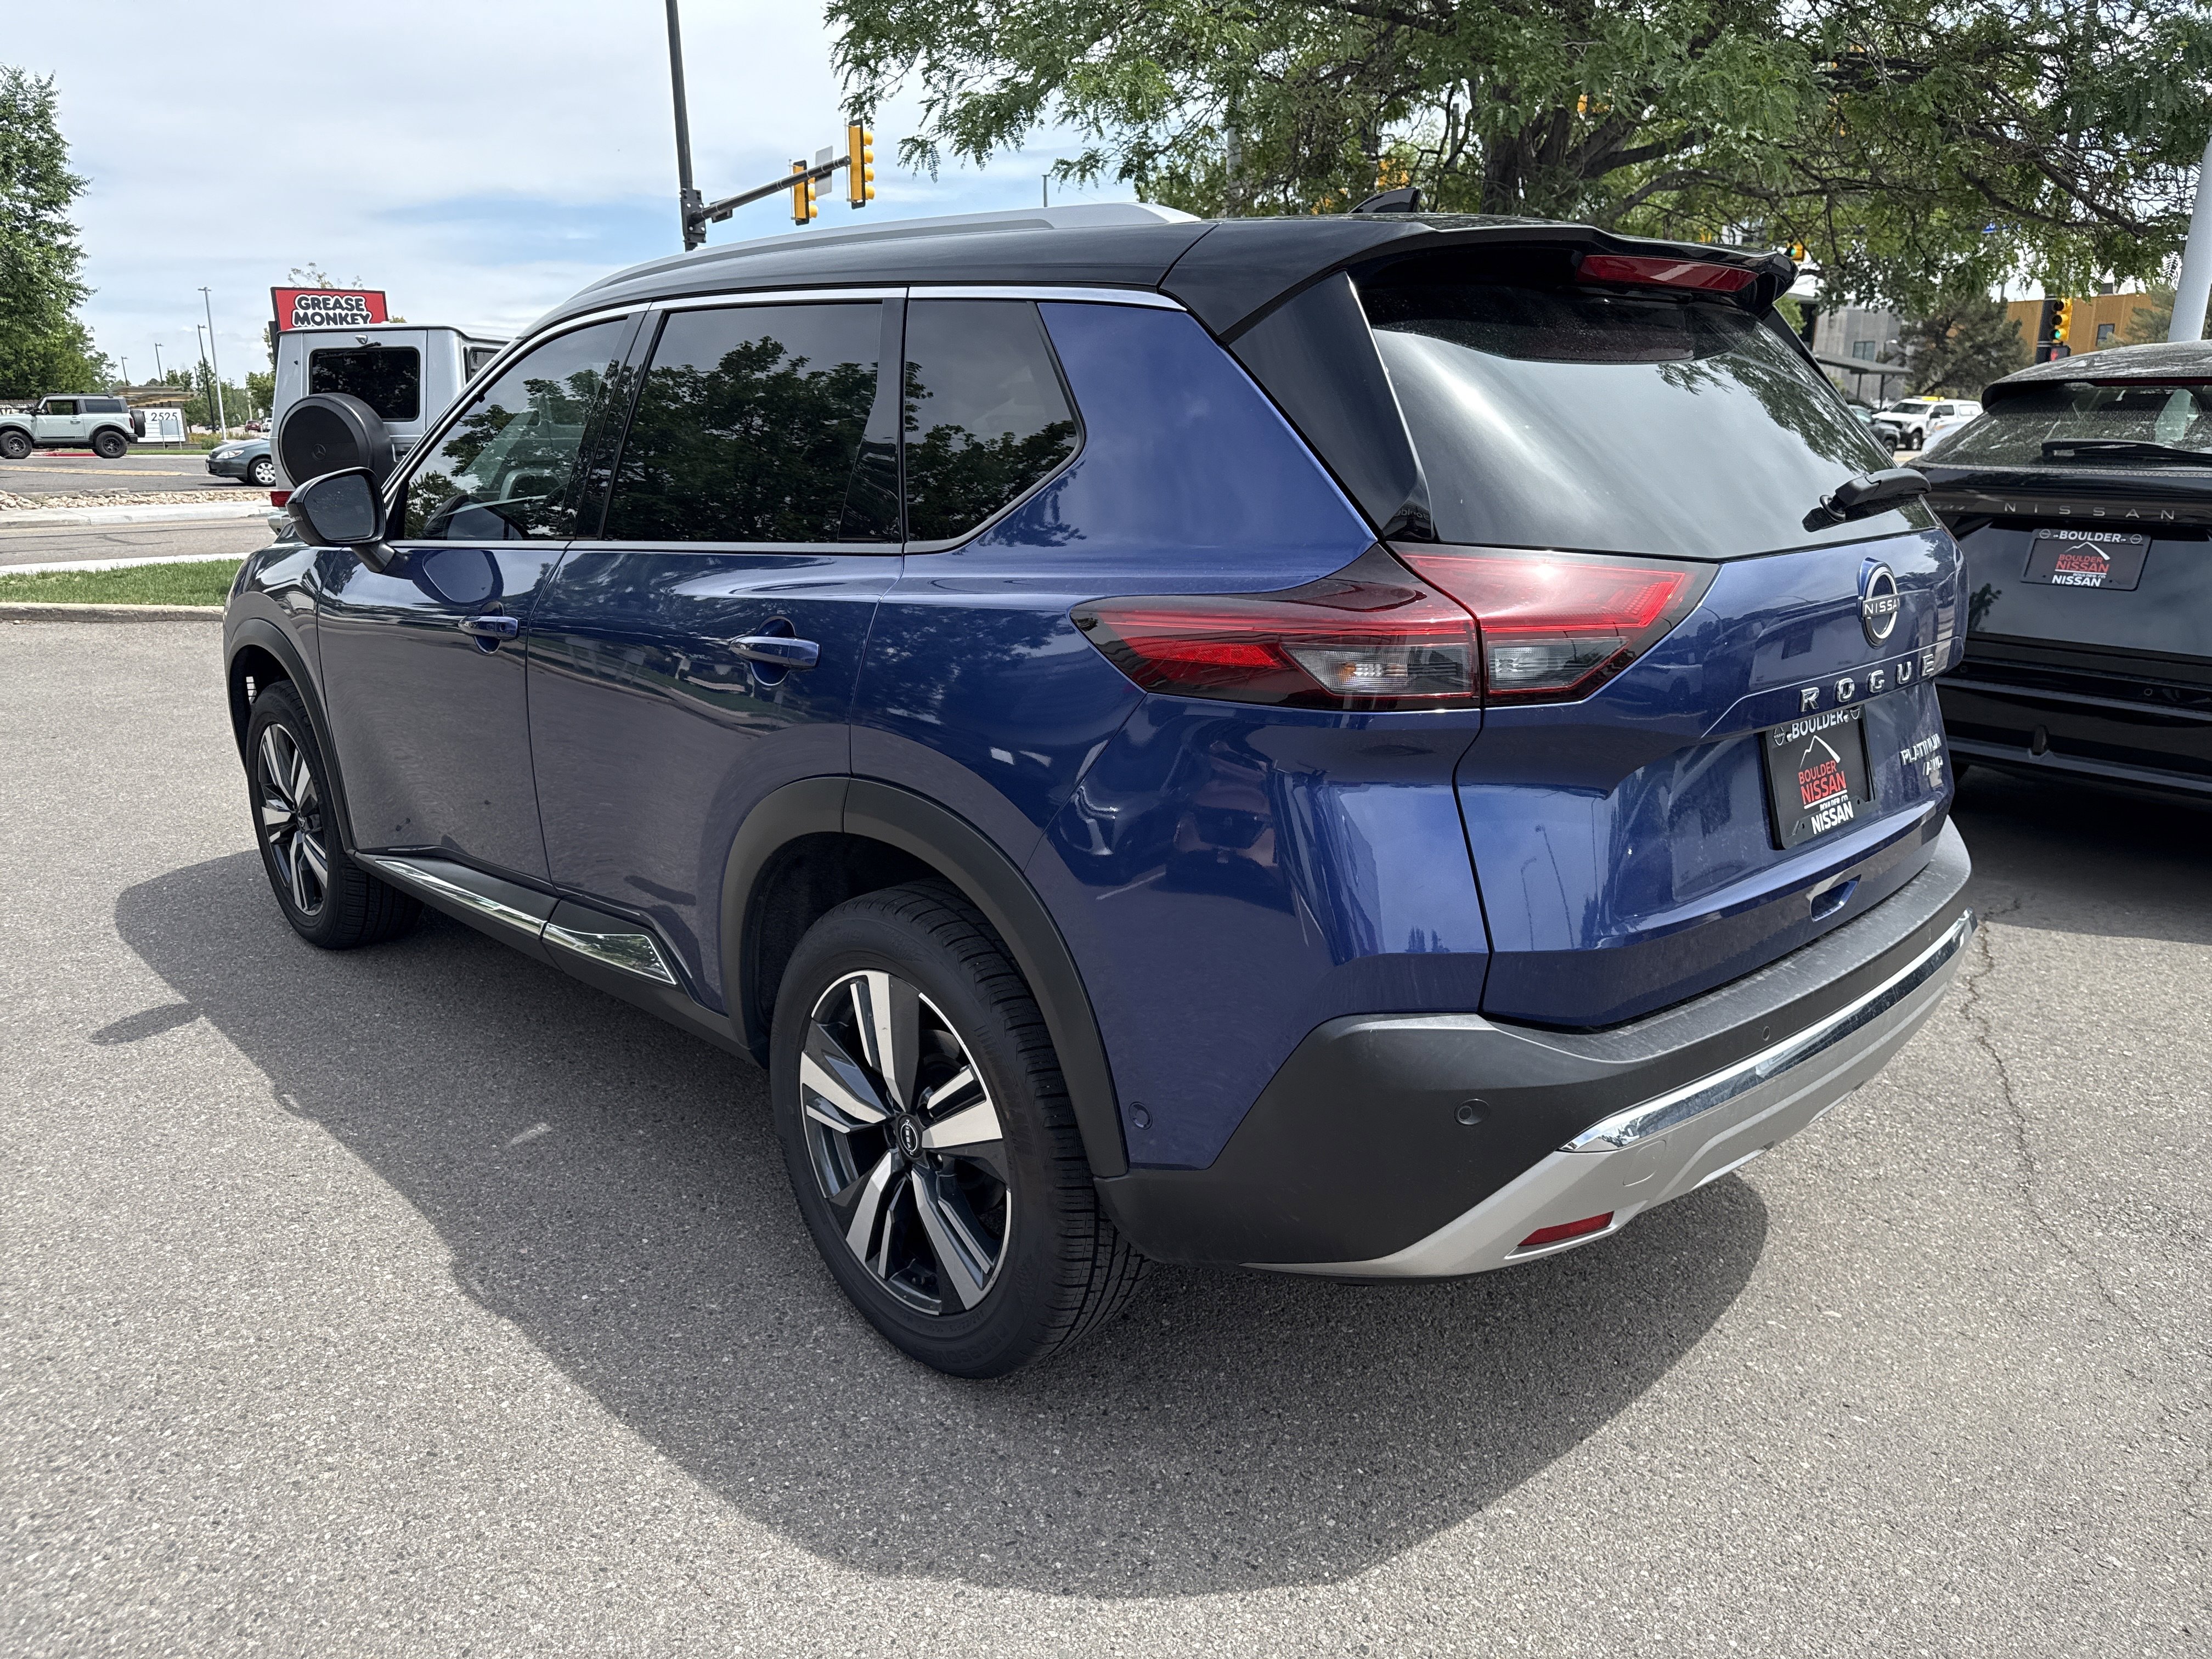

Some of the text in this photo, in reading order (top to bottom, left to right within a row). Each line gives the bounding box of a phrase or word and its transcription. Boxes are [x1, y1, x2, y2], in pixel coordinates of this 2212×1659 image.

[296, 296, 365, 312] GREASE
[294, 312, 370, 326] MONKEY
[151, 412, 177, 422] 2525
[2005, 502, 2175, 520] NISSAN
[2059, 531, 2121, 543] BOULDER
[2056, 561, 2109, 572] NISSAN
[2058, 554, 2103, 563] BOULDER
[2051, 575, 2101, 587] NISSAN
[1800, 653, 1934, 713] ROGUE
[1792, 710, 1844, 740] BOULDER
[1798, 760, 1837, 785] BOULDER
[1801, 771, 1847, 805] NISSAN
[1811, 801, 1854, 834] NISSAN
[905, 1119, 914, 1155] NISSAN
